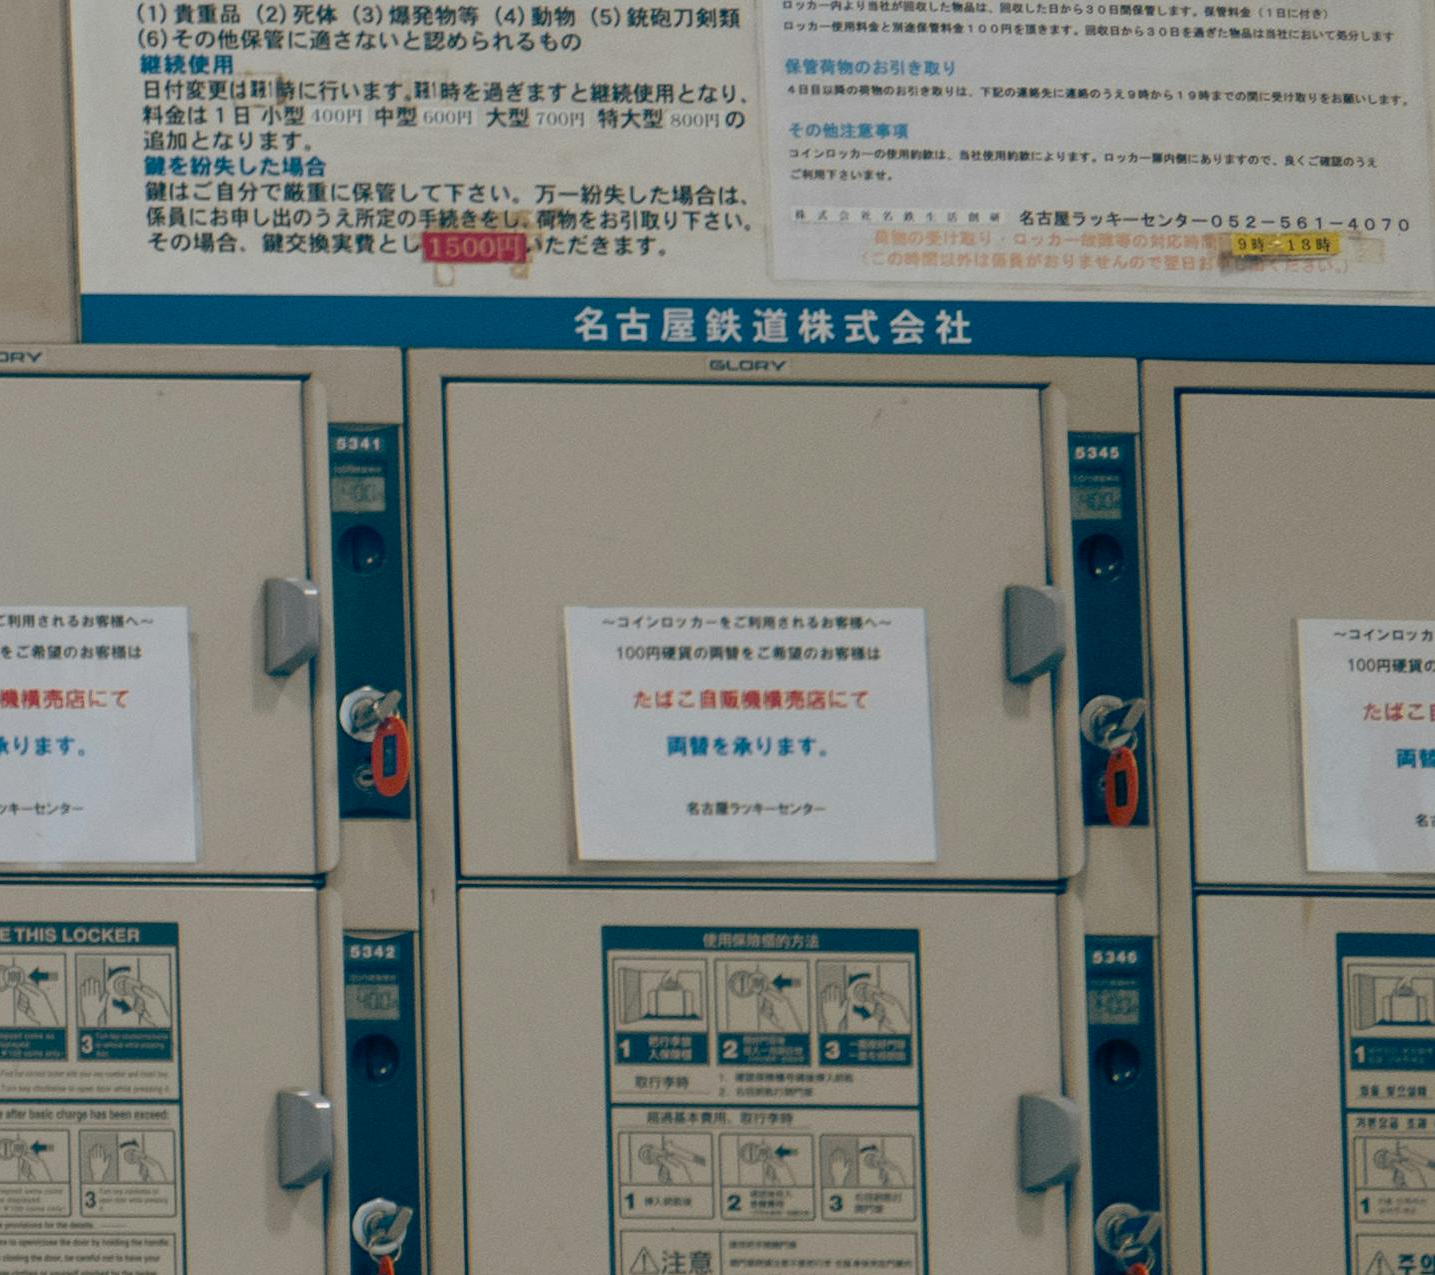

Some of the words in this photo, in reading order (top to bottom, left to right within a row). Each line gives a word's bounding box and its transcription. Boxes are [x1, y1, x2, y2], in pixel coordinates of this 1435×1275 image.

[137, 4, 240, 25] (1)貴重品
[256, 5, 337, 26] (2)死体
[353, 6, 479, 27] (3)爆発物等
[495, 7, 576, 28] (4)動物
[591, 7, 740, 29] (5)銃砲刀剣類
[138, 29, 582, 52] (6)その他保管に適さないと認められるもの
[139, 54, 234, 75] 継続使用
[785, 58, 956, 77] 保管荷物のお引き取り
[261, 106, 304, 127] 小型
[311, 109, 363, 124] 400円
[374, 107, 417, 127] 中型
[423, 110, 473, 125] 600円
[487, 108, 529, 129] 大型
[536, 111, 585, 127] 700円
[598, 109, 663, 129] 特大型
[670, 112, 720, 128] 800円
[725, 110, 746, 128] の
[144, 130, 312, 152] 追加となります。
[789, 122, 909, 140] その他注意事項
[144, 156, 326, 177] 鍵を紛失した場合
[790, 169, 893, 182] ご利用下さいませ。
[428, 236, 524, 259] 1500円
[574, 306, 973, 346] 名古屋鉄道株式会社
[709, 359, 788, 371] GLORY
[335, 439, 380, 451] 5341
[1075, 447, 1118, 460] 5345
[634, 688, 869, 711] たばこ自販機横売店にて
[15, 927, 56, 943] THIS
[62, 927, 140, 943] LOCKER
[350, 946, 394, 959] 5342
[661, 1250, 714, 1275] 注意
